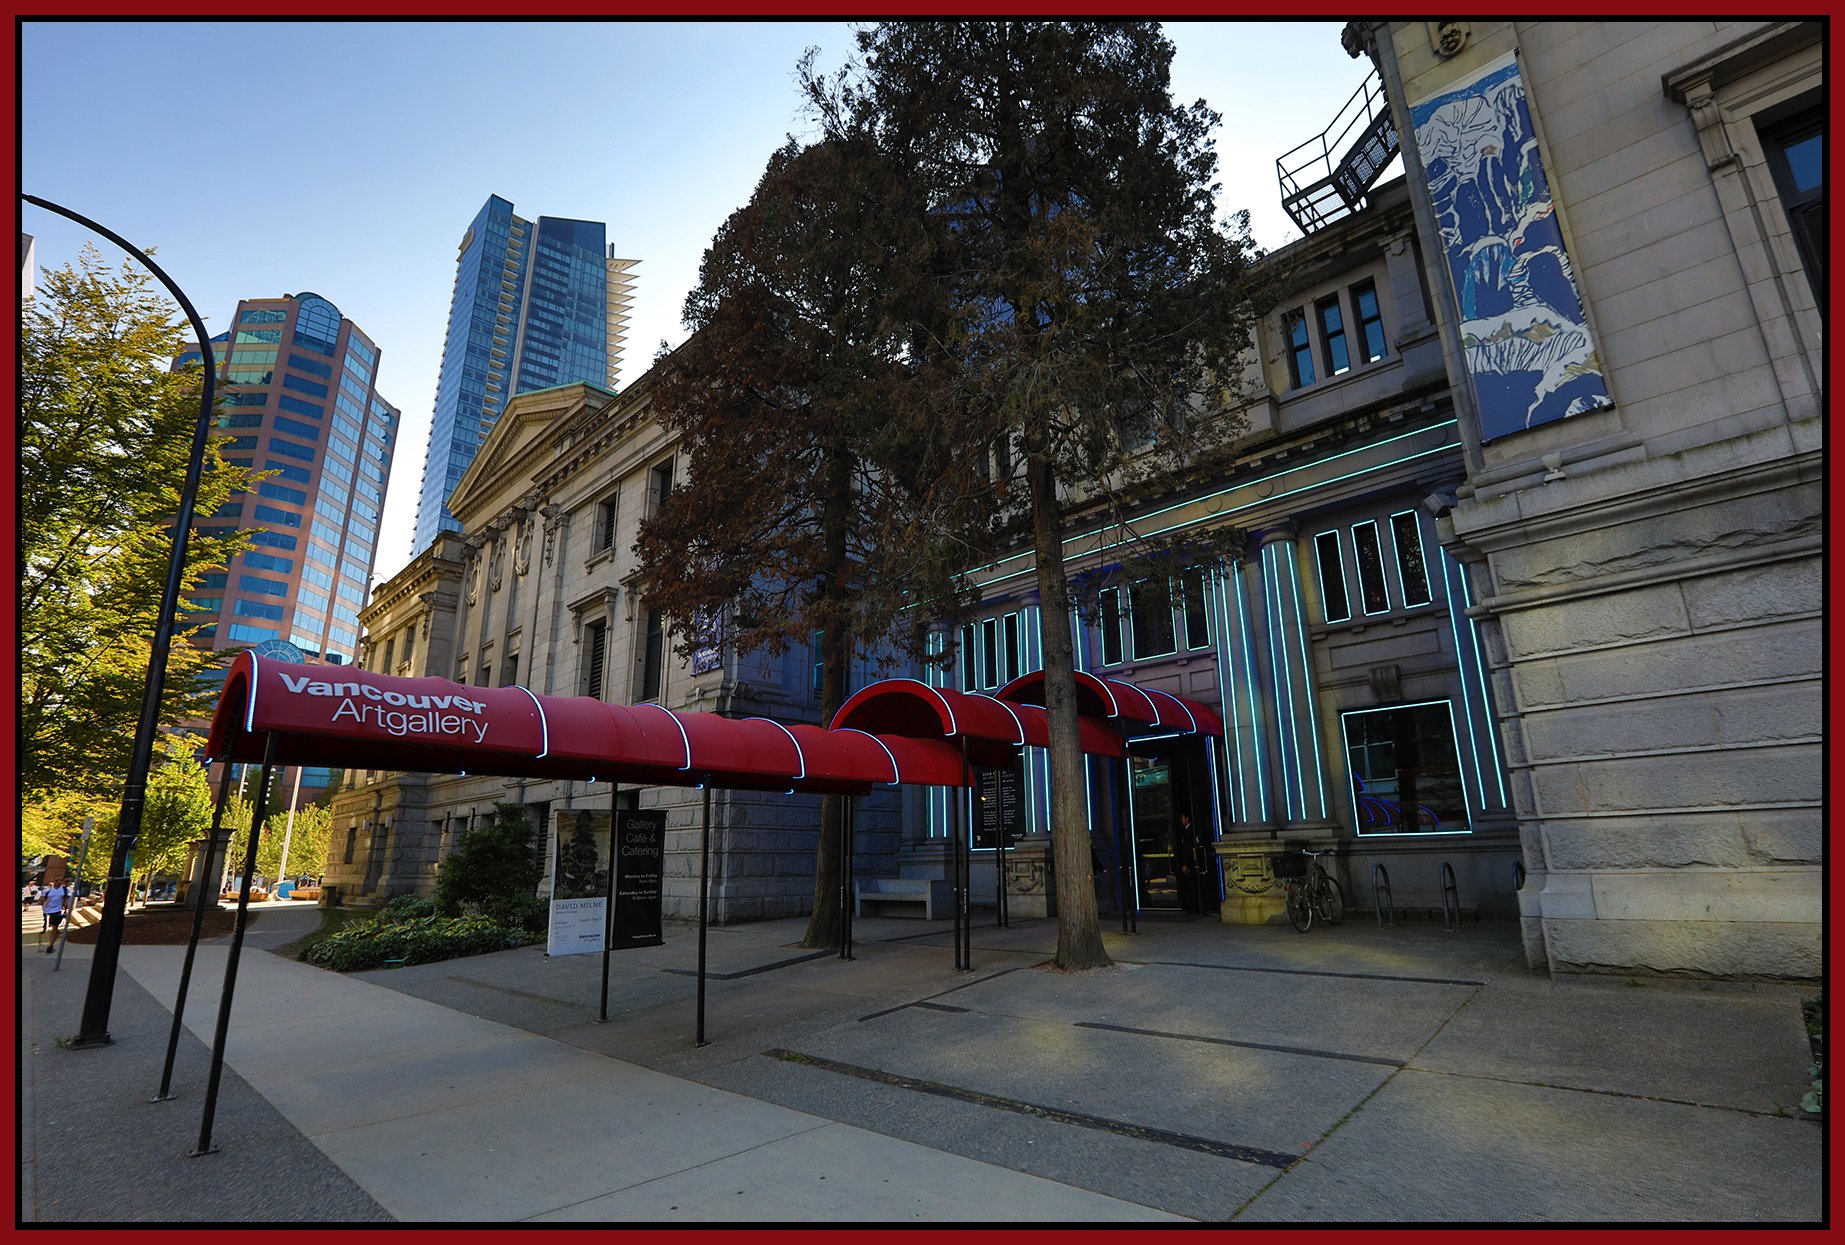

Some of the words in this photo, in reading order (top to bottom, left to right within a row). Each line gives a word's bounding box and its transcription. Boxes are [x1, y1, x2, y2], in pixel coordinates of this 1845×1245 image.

[278, 672, 487, 715] Vancouver
[331, 697, 489, 743] Artgallery
[626, 819, 657, 831] Gallery
[625, 832, 648, 843] Café
[649, 832, 656, 843] &
[621, 845, 659, 858] Catering
[580, 901, 602, 909] MILNE
